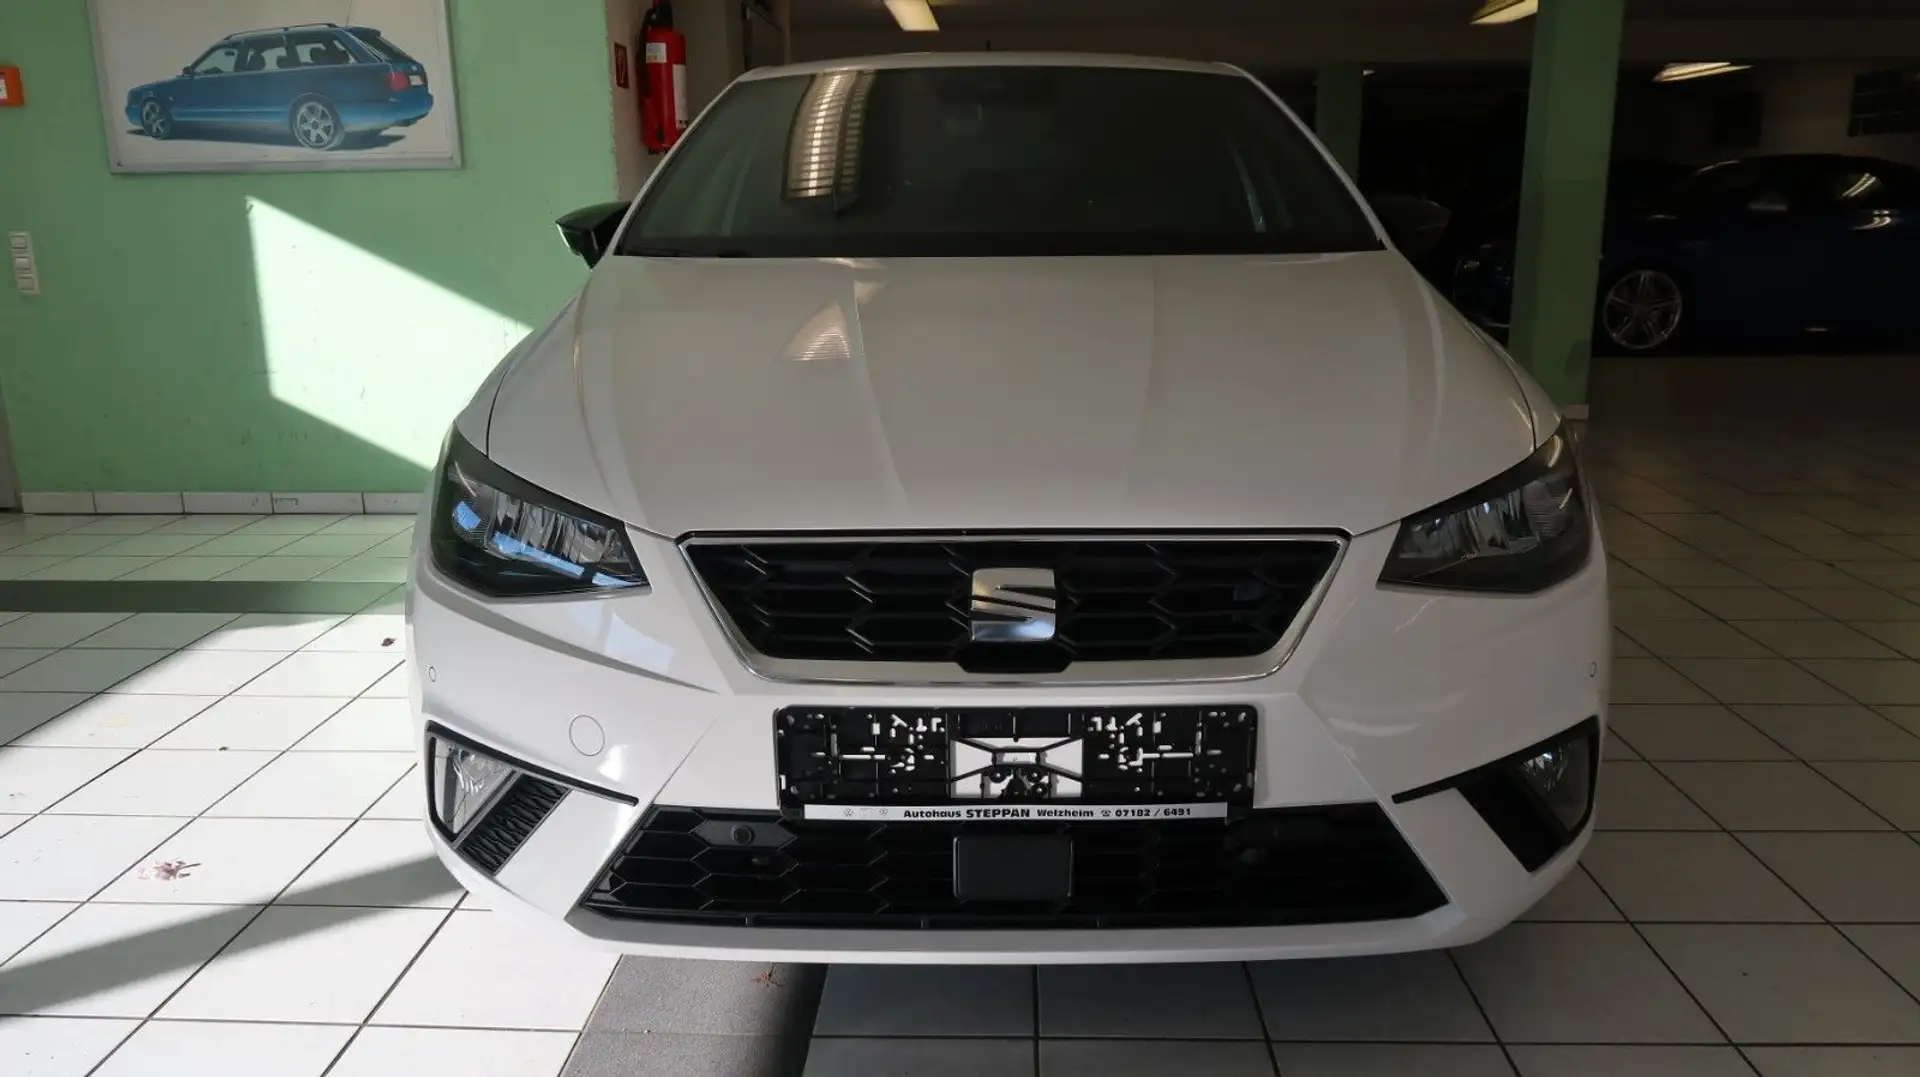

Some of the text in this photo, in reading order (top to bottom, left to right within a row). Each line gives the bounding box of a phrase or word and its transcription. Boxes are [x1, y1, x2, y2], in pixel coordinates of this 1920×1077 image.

[903, 810, 963, 818] Autohaus
[966, 808, 1030, 818] STEPPAN
[1036, 808, 1094, 817] Welzheim
[1115, 808, 1151, 817] 07182
